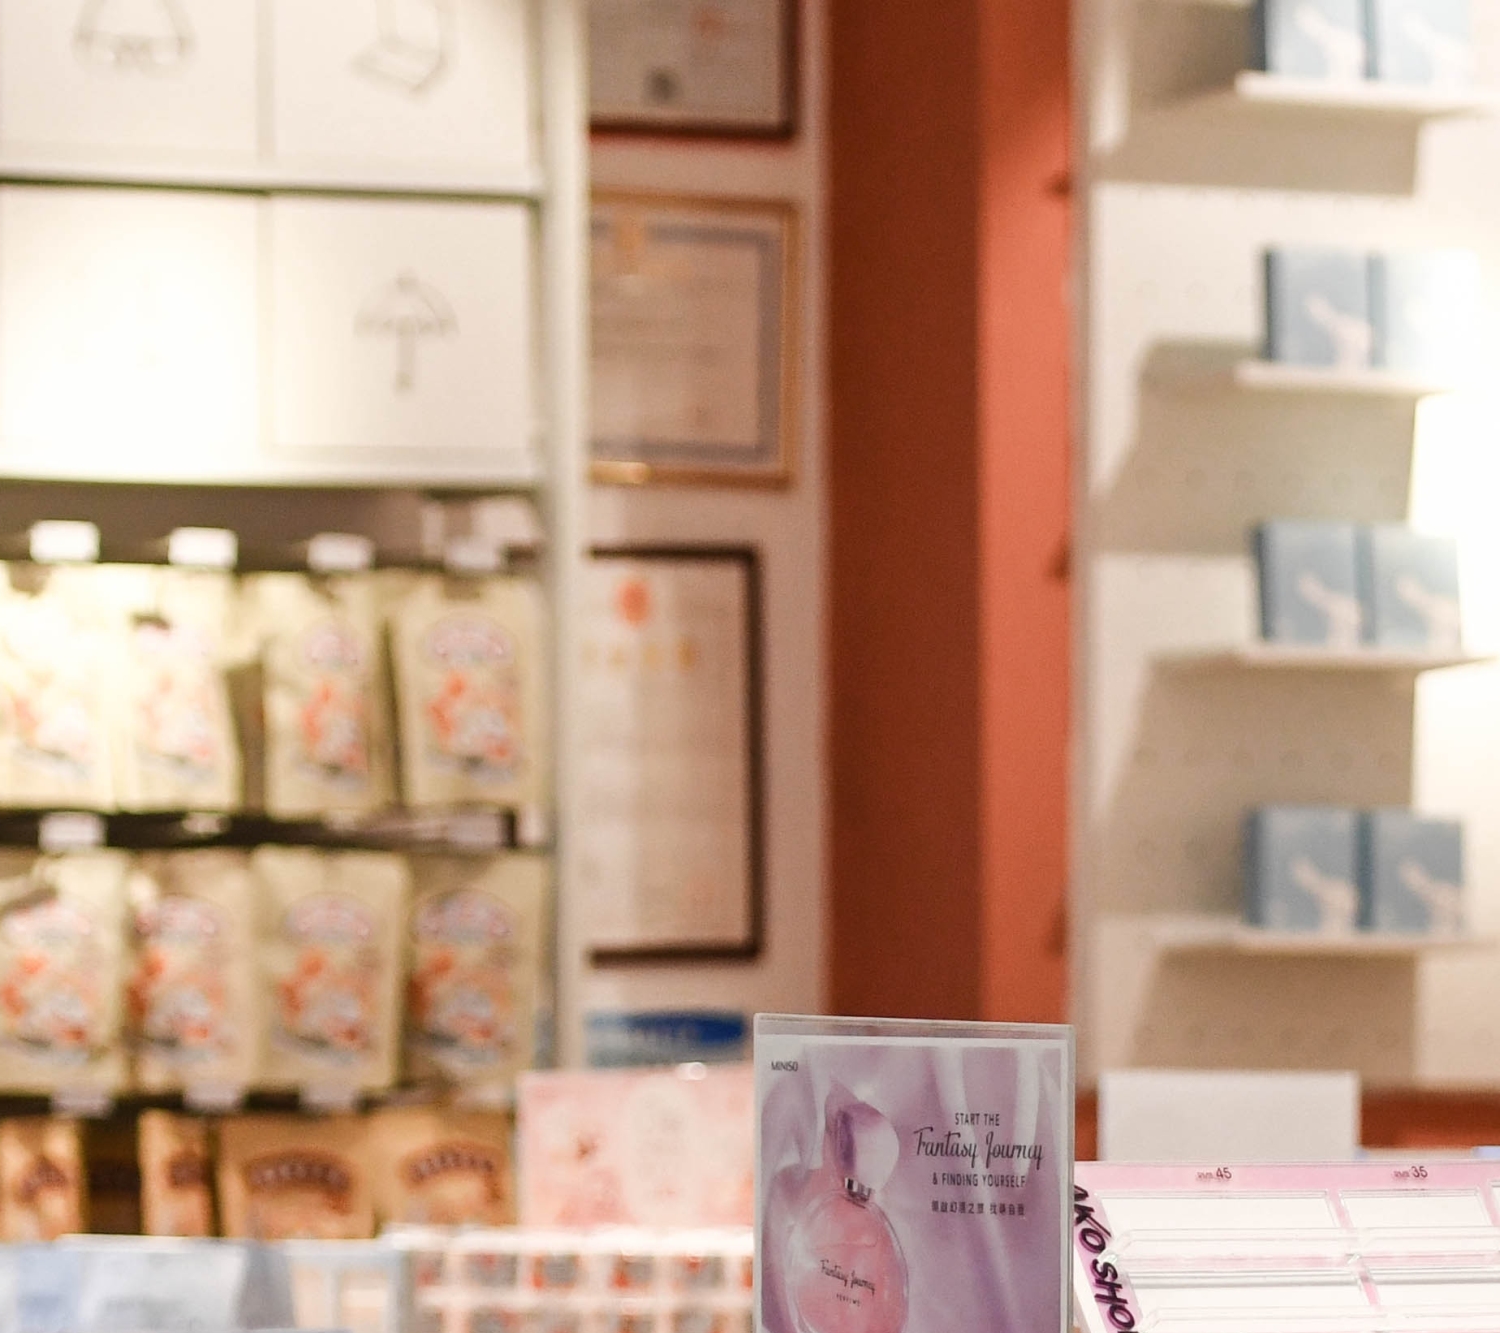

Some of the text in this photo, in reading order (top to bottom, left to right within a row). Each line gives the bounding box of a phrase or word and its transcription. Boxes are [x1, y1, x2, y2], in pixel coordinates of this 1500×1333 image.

[771, 1061, 798, 1072] MINISO
[955, 1112, 1000, 1126] START THE
[913, 1126, 1043, 1170] Fantasy Journey
[1215, 1167, 1232, 1180] 45
[1411, 1166, 1428, 1178] 35
[942, 1173, 979, 1187] FINDING
[982, 1174, 1026, 1188] YOURSELF
